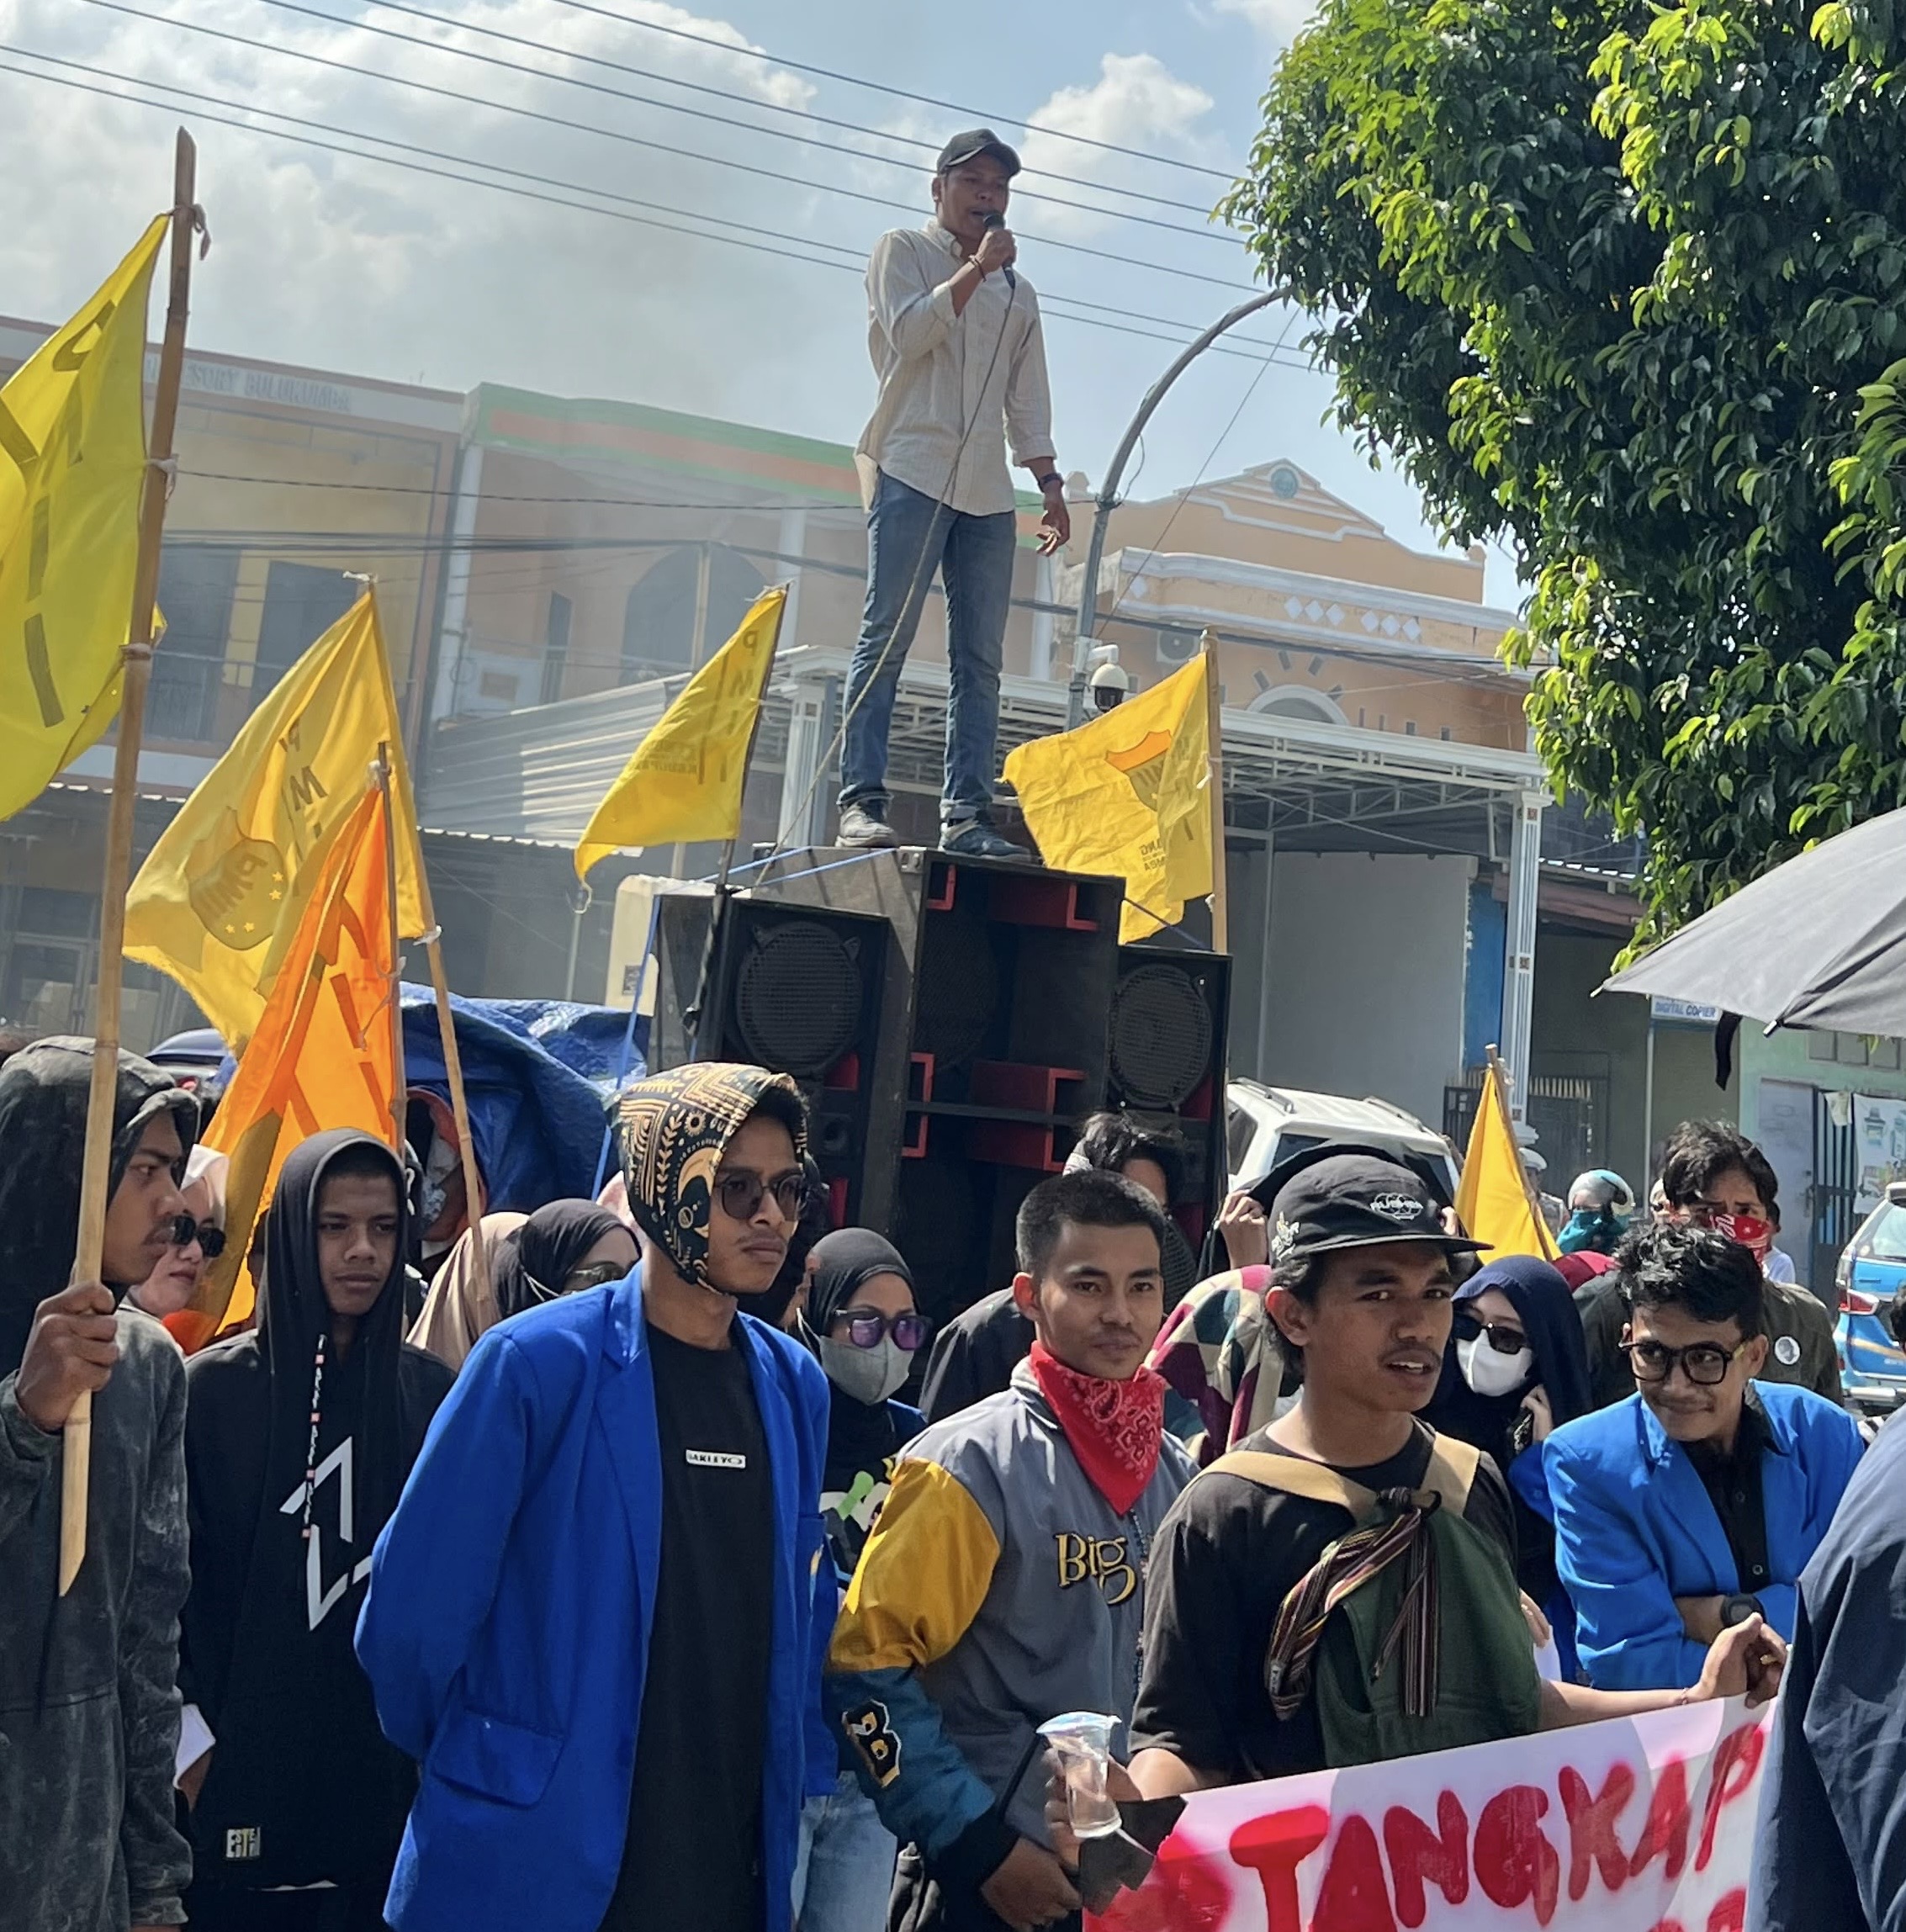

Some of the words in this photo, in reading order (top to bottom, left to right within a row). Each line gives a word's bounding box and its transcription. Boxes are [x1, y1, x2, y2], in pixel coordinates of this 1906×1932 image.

[1686, 1003, 1716, 1018] COPIER
[1055, 1532, 1136, 1605] Big
[1229, 1723, 1765, 1932] TANGKAP
